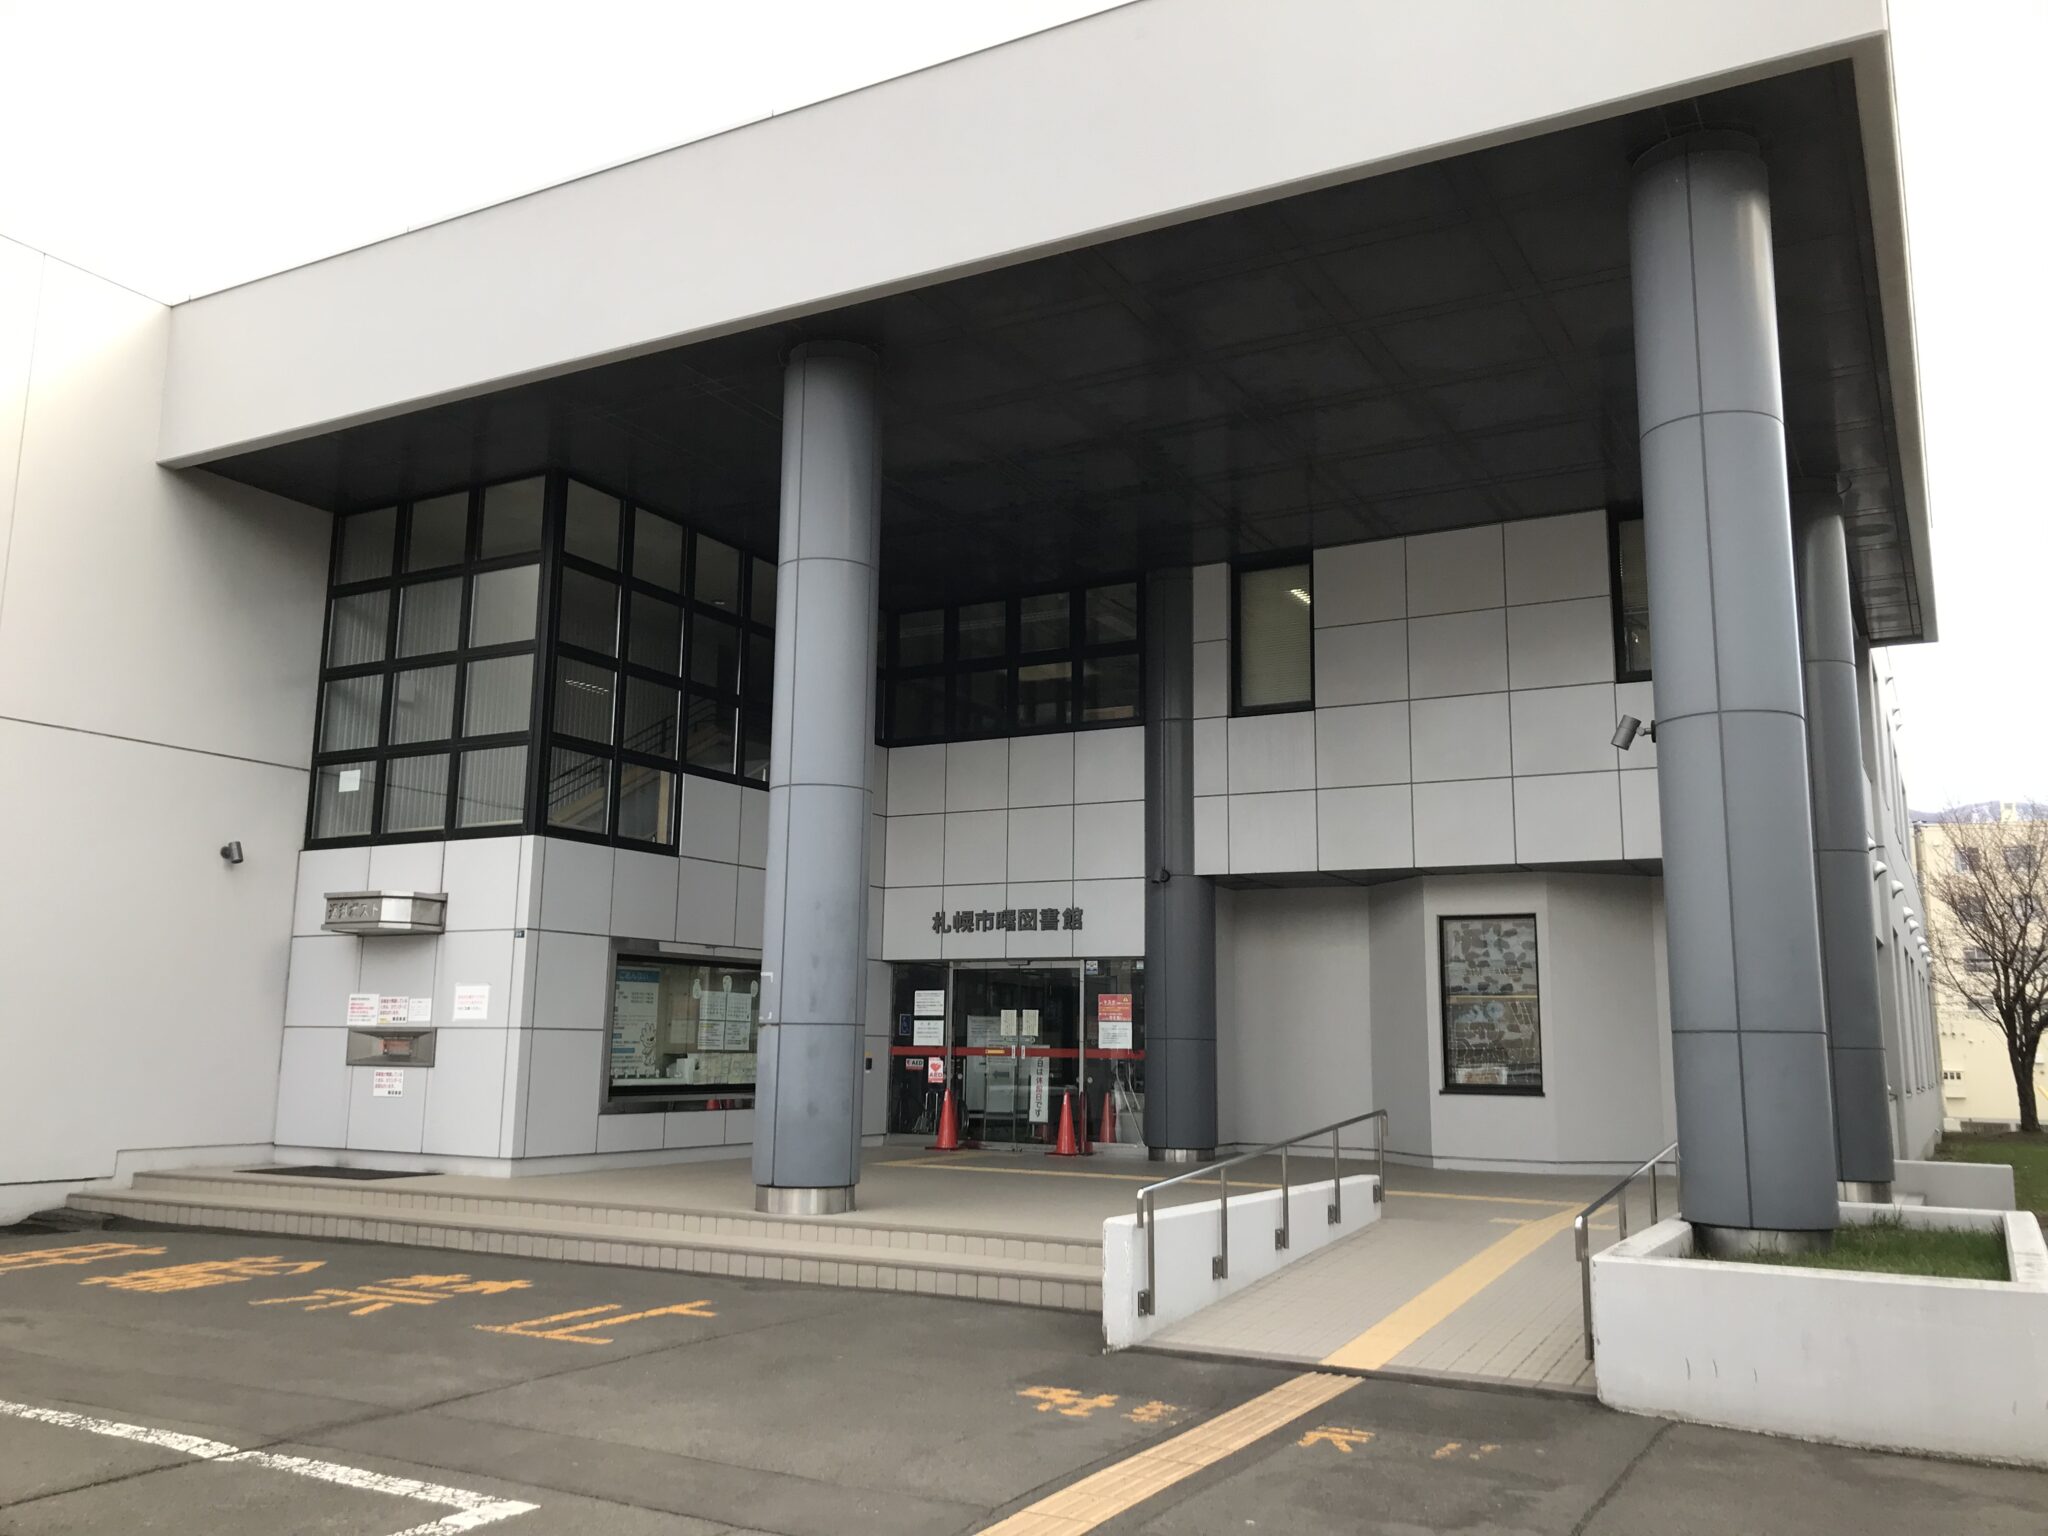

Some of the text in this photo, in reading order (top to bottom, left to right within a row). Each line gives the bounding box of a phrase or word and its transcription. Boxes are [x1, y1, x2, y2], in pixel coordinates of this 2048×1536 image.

[932, 908, 1084, 933] 札幌市曙図書館
[1035, 1057, 1044, 1118] 日は休館日です
